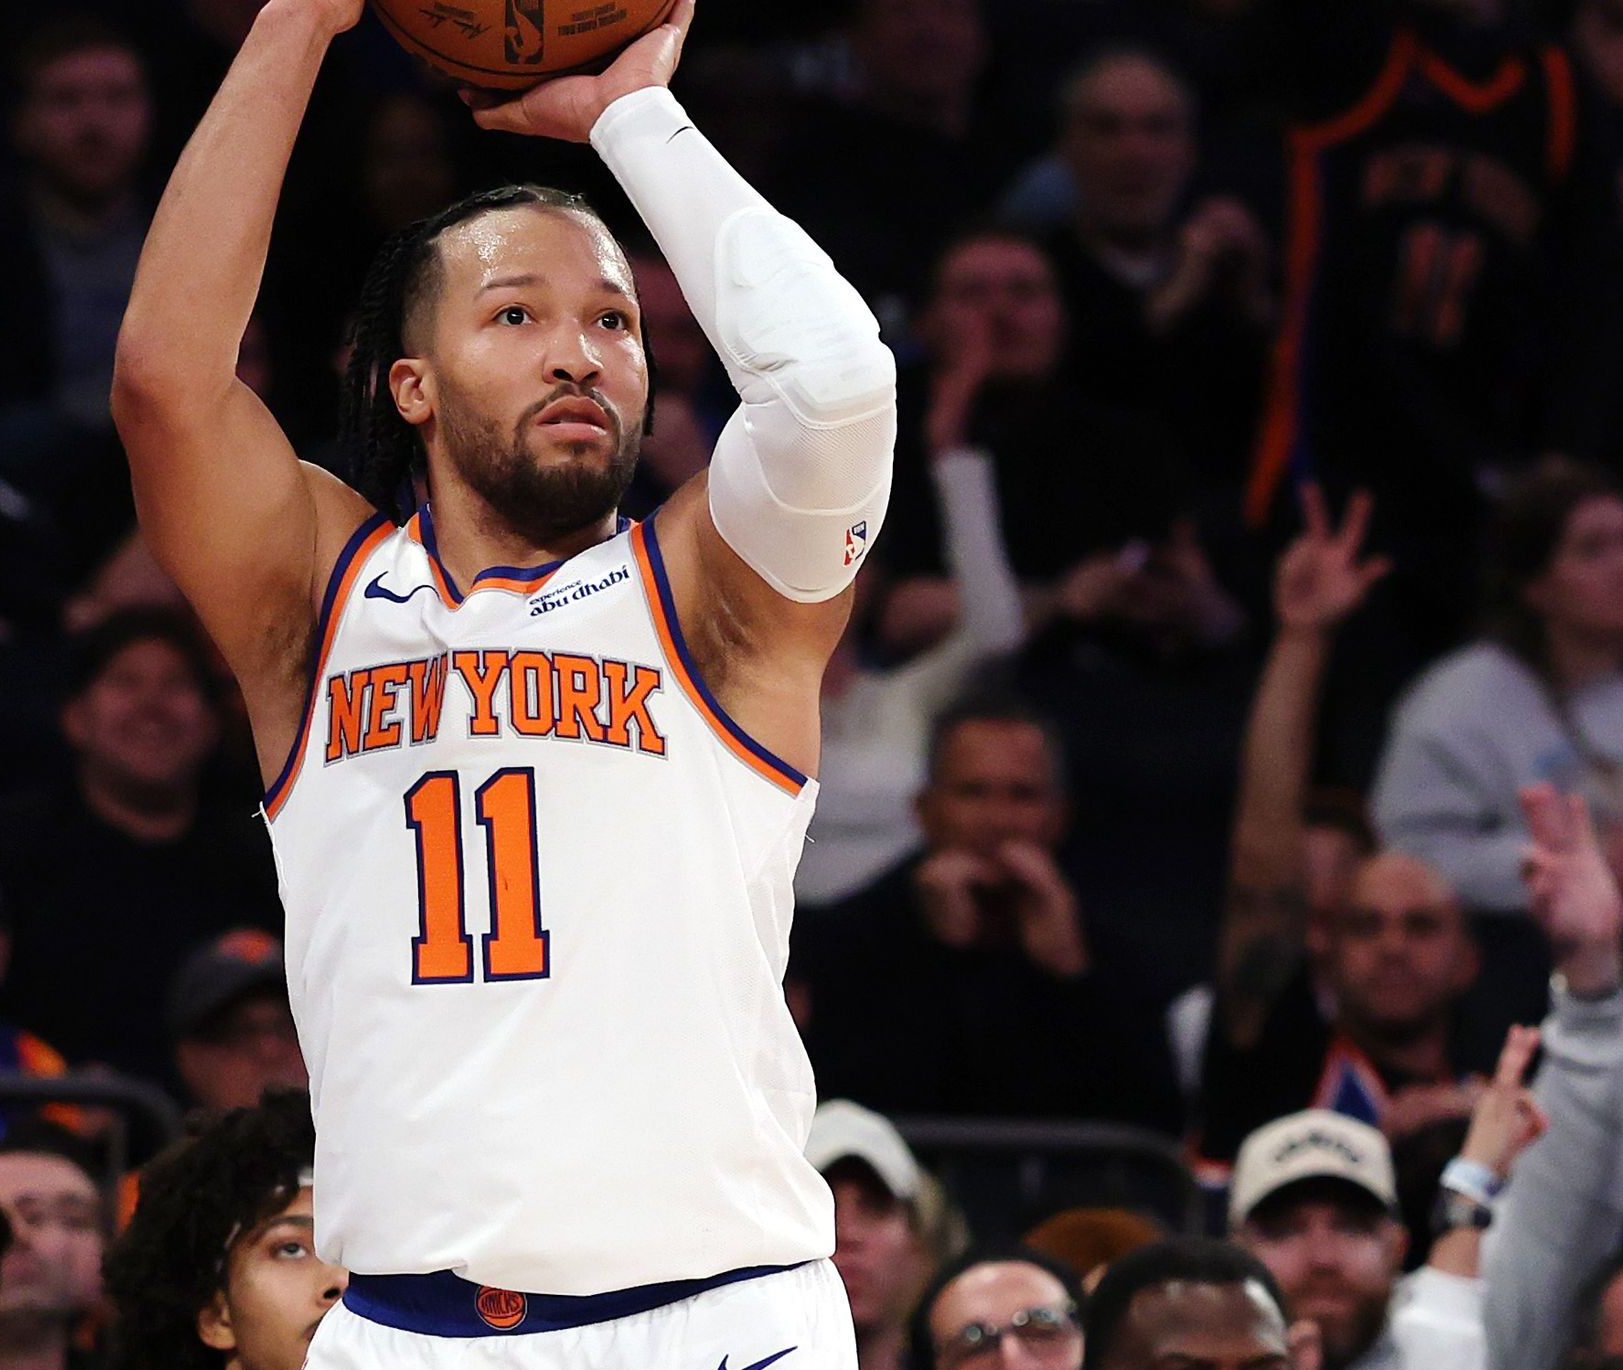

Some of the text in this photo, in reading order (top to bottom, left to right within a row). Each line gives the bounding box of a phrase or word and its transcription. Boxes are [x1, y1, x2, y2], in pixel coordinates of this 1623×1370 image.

[529, 580, 582, 605] experience
[530, 565, 630, 617] abu dhabi
[324, 647, 669, 767] NEW YORK
[404, 767, 550, 985] 11
